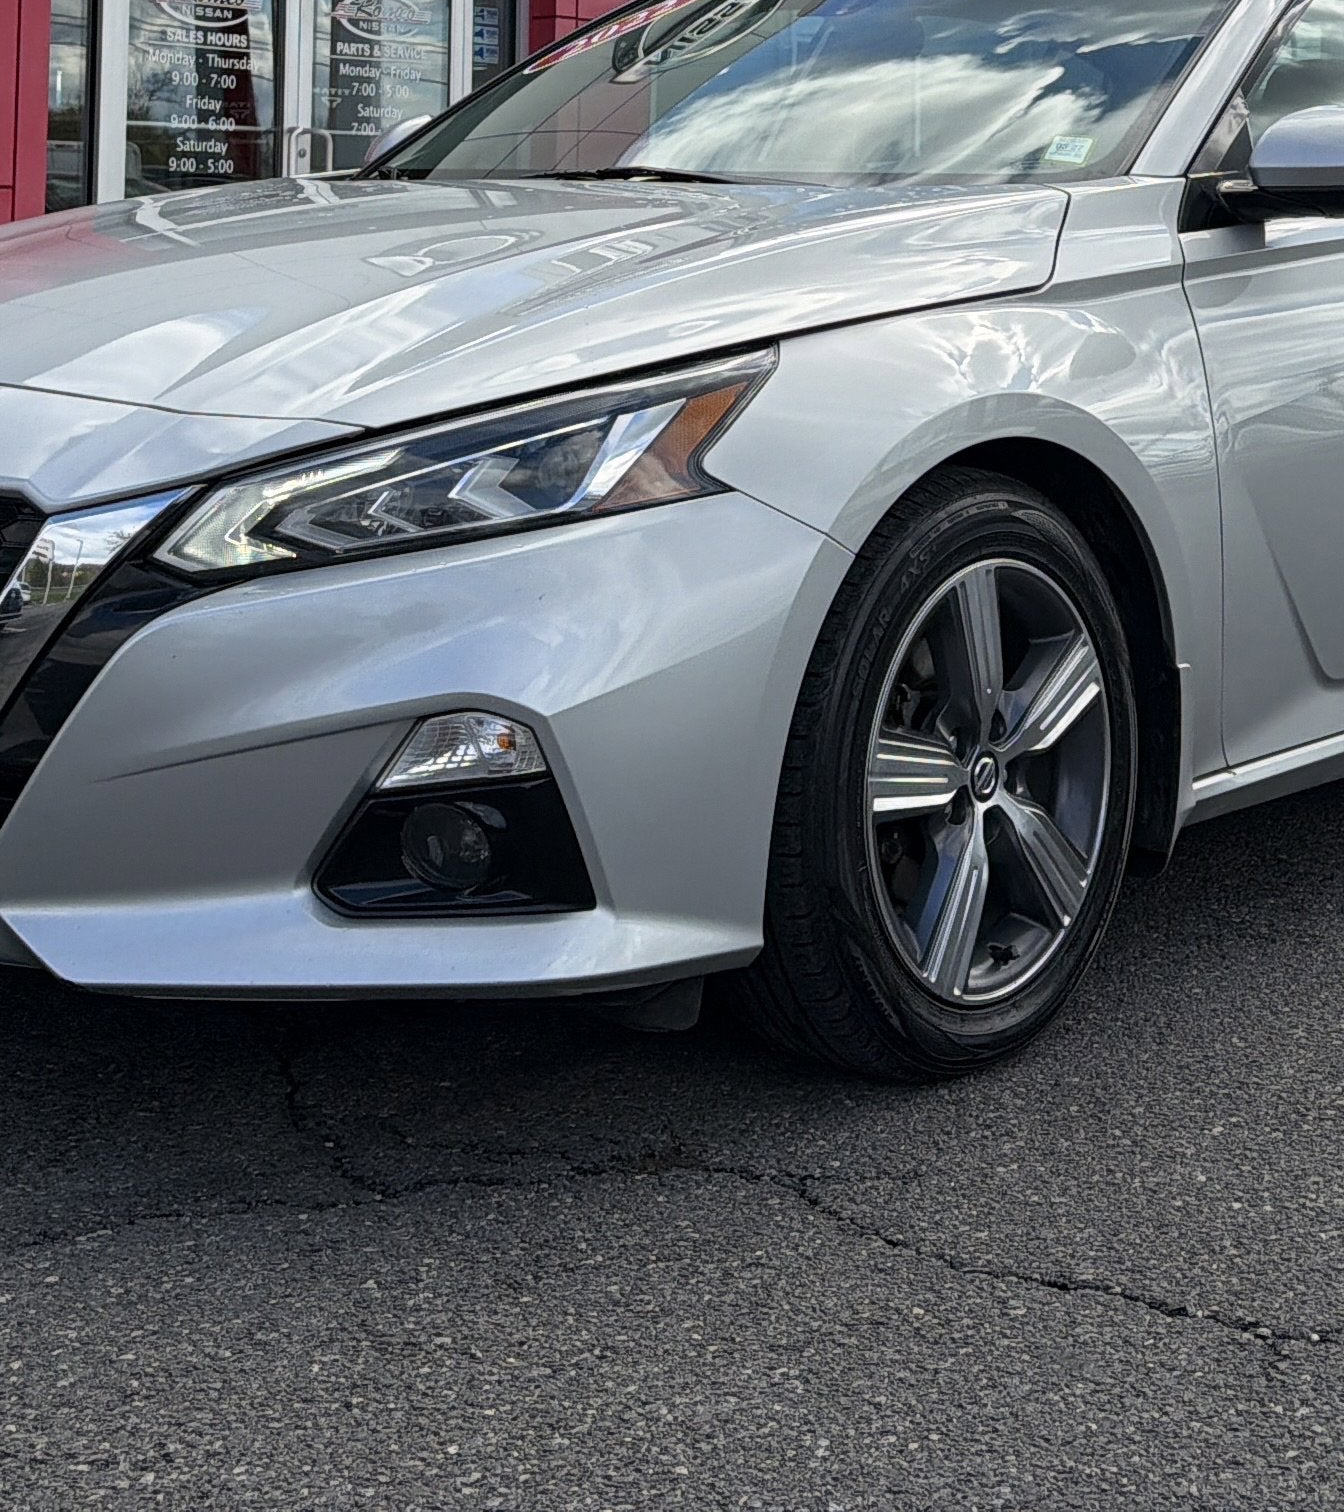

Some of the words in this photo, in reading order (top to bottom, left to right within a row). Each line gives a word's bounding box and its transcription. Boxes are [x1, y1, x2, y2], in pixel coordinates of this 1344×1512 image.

[182, 5, 233, 19] NISSAN
[166, 28, 205, 44] SALES
[207, 31, 248, 48] HOURS
[336, 42, 371, 56] PARTS
[373, 44, 381, 57] &
[383, 45, 428, 60] SERVICE
[148, 49, 195, 67] Monday
[206, 54, 258, 72] Thursday
[209, 73, 237, 89] 7:00
[339, 62, 382, 80] Monday
[390, 66, 422, 83] Friday
[351, 82, 376, 96] 7:00
[186, 94, 222, 113] Friday
[357, 103, 404, 121] Saturday
[170, 114, 198, 129] 9:00
[208, 116, 236, 131] 6:00
[350, 122, 376, 136] 7:00
[176, 136, 229, 156] Saturday
[168, 157, 197, 172] 9:00
[207, 158, 234, 174] 5:00
